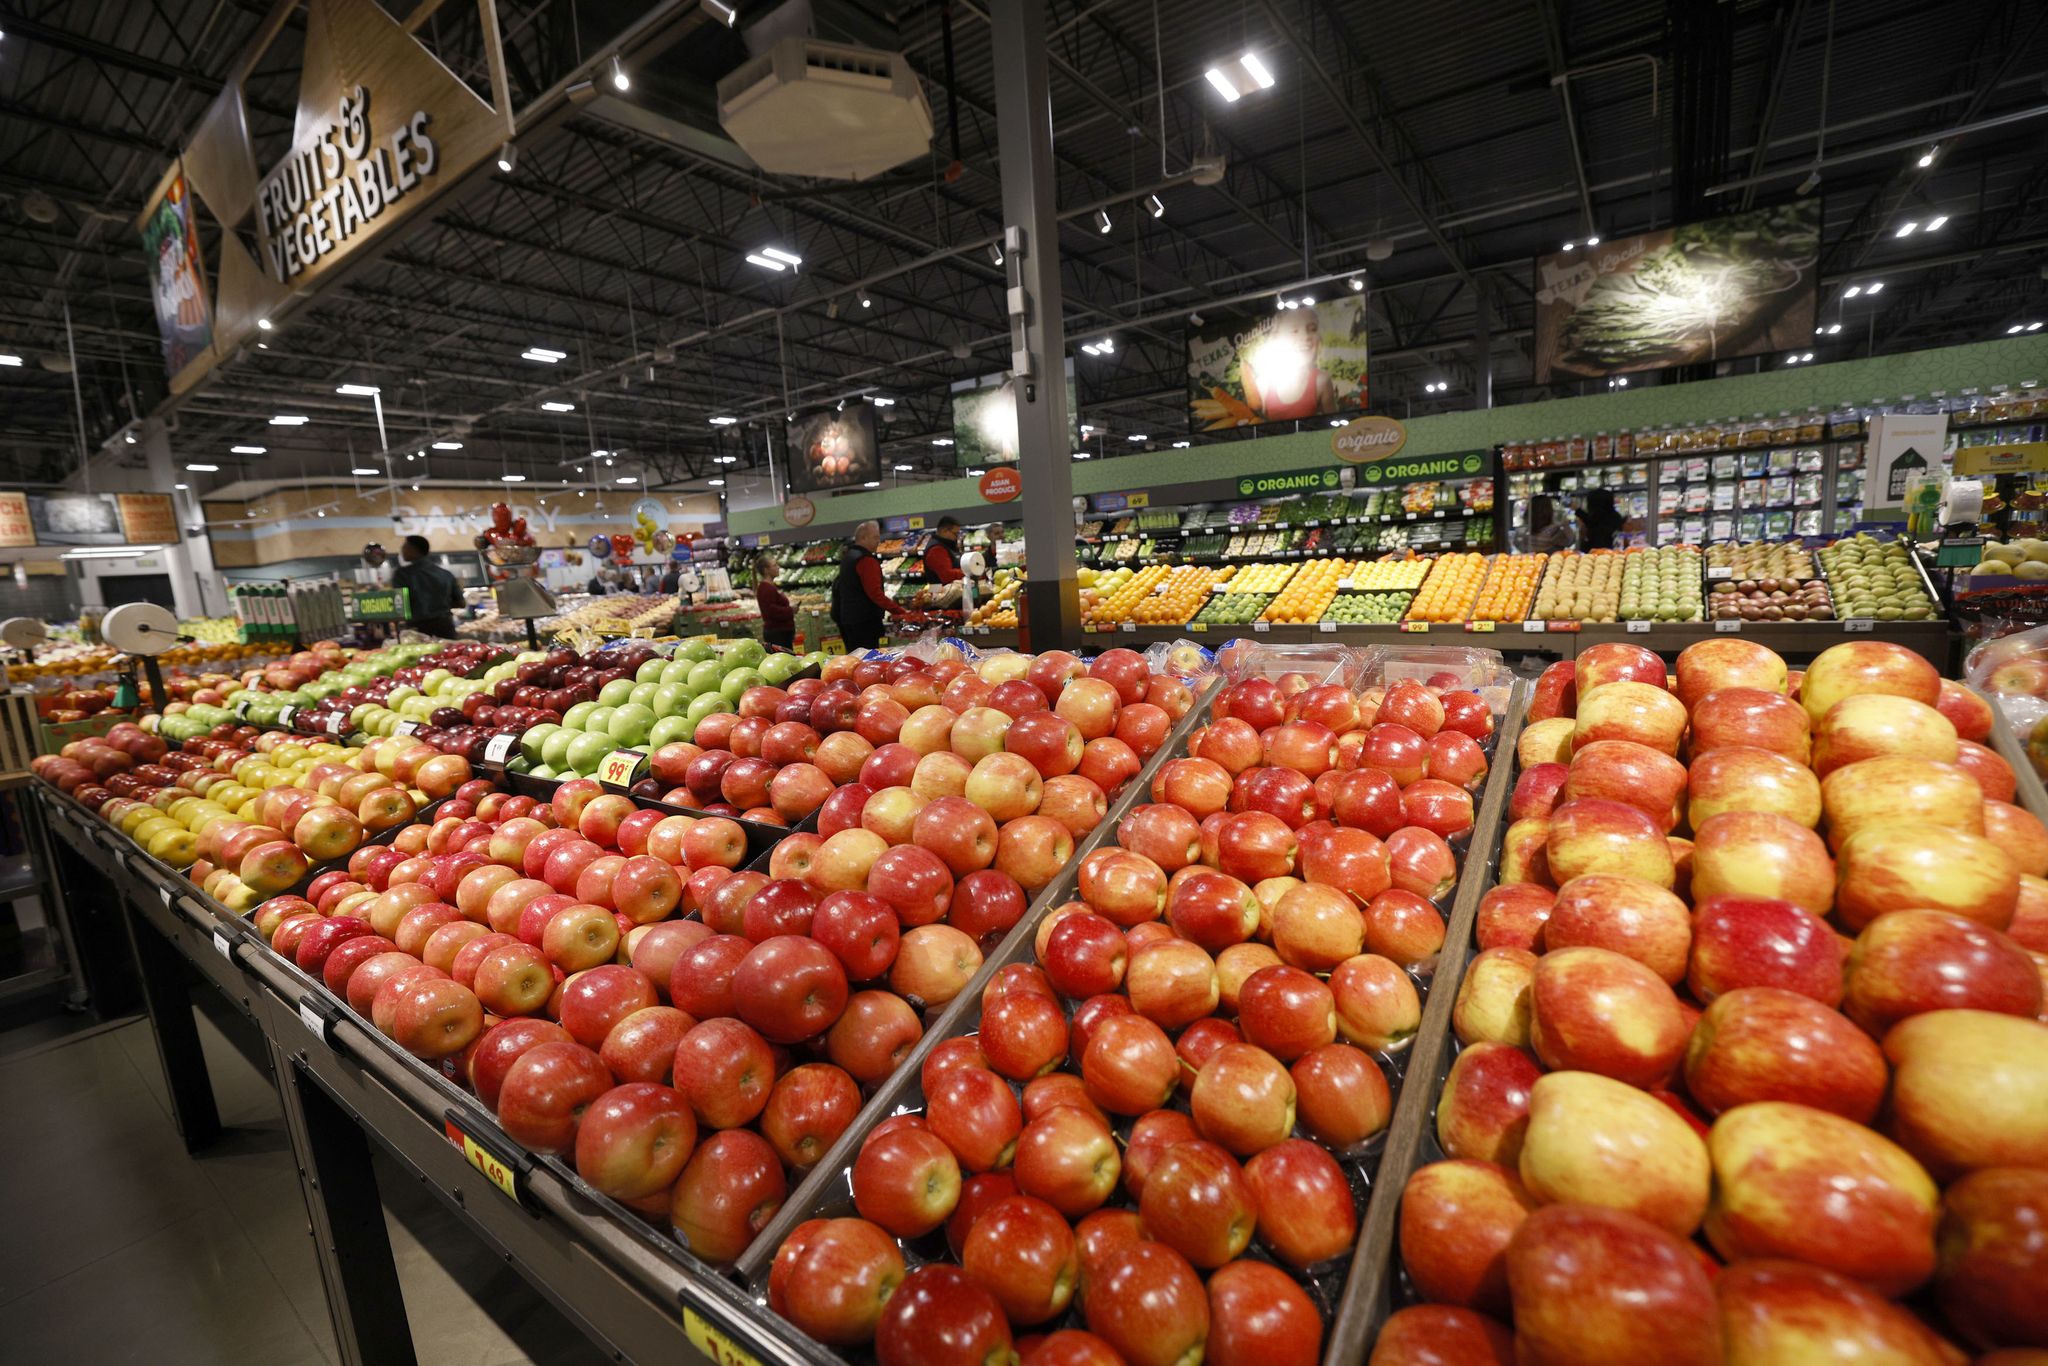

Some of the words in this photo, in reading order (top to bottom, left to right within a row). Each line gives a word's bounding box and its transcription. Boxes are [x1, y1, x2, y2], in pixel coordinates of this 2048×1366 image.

[259, 124, 341, 237] FRUITS
[339, 84, 369, 161] &
[268, 110, 437, 284] VEGETABLES
[1550, 269, 1590, 296] TEXAS
[1598, 240, 1645, 275] Local
[1200, 345, 1229, 369] TEXAS
[1234, 315, 1279, 349] Quality
[1337, 427, 1400, 452] organic
[1386, 459, 1459, 478] ORGANIC
[985, 485, 1016, 496] PRODUCE
[991, 479, 1010, 488] ASIAN
[1257, 474, 1320, 492] ORGANIC
[393, 504, 561, 537] BAKRY
[361, 597, 394, 614] ORGANIC
